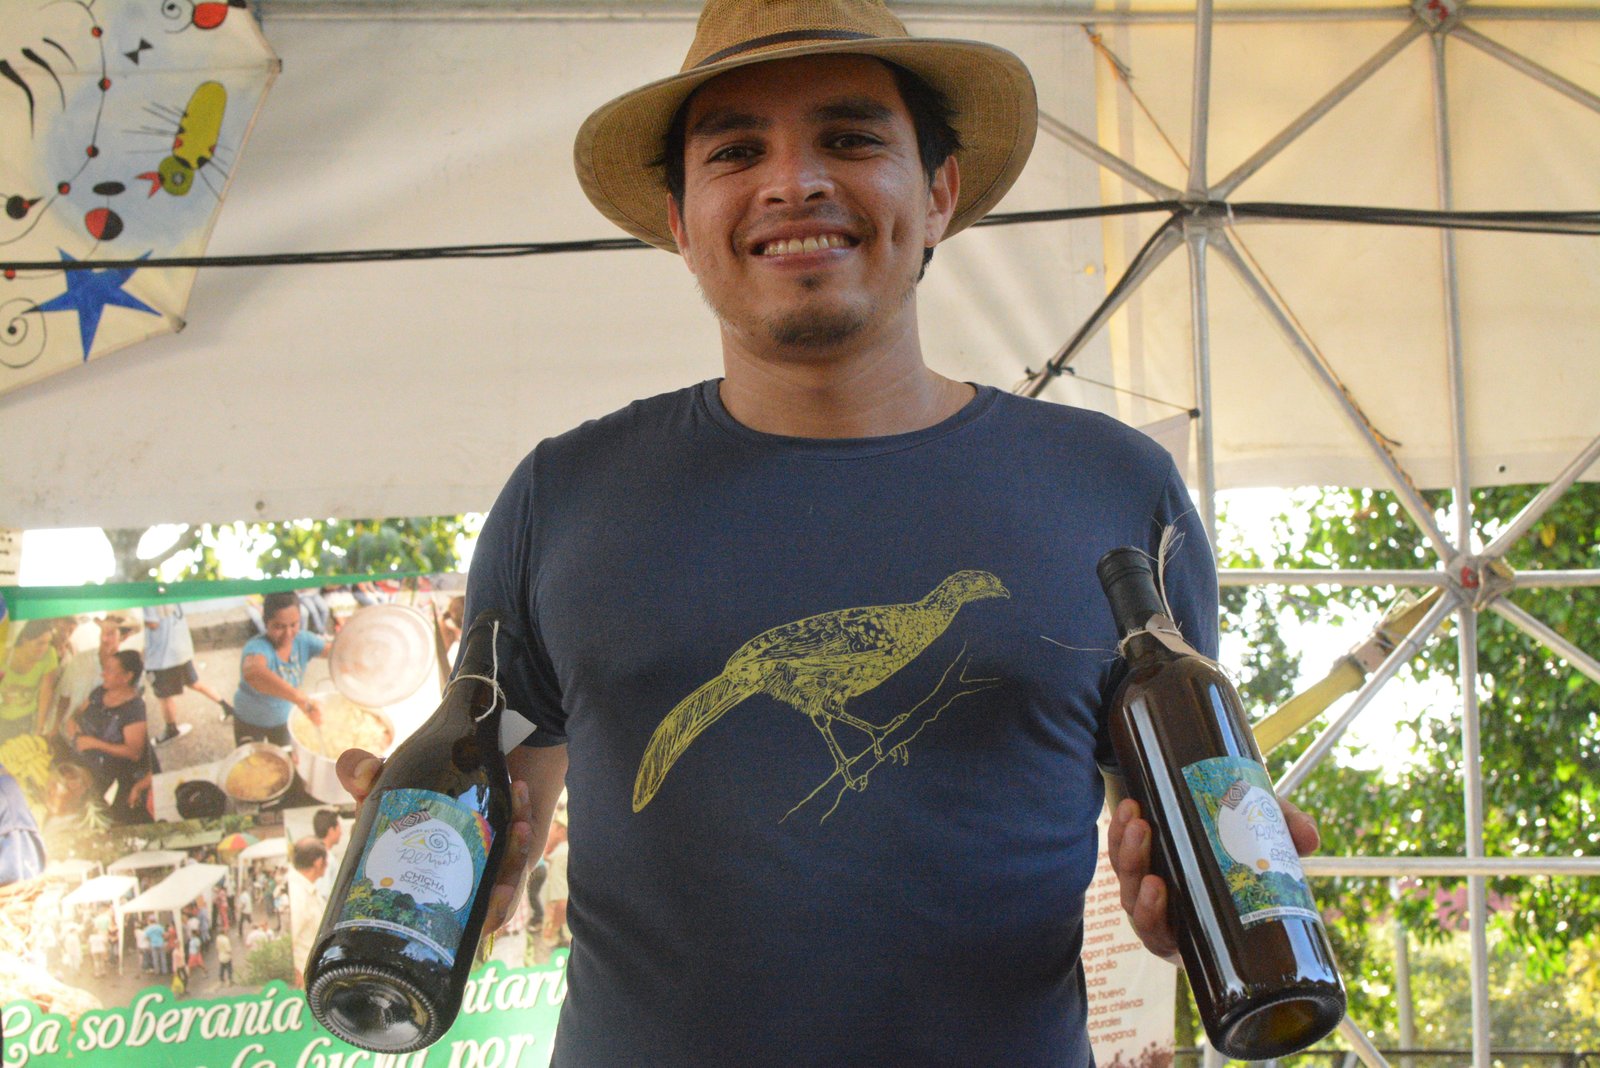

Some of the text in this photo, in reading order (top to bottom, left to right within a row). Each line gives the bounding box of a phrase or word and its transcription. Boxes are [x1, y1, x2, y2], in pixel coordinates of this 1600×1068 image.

[404, 870, 446, 893] CHICHA
[3, 954, 568, 1068] La soberanía ntari
[1087, 1017, 1122, 1031] aturales
